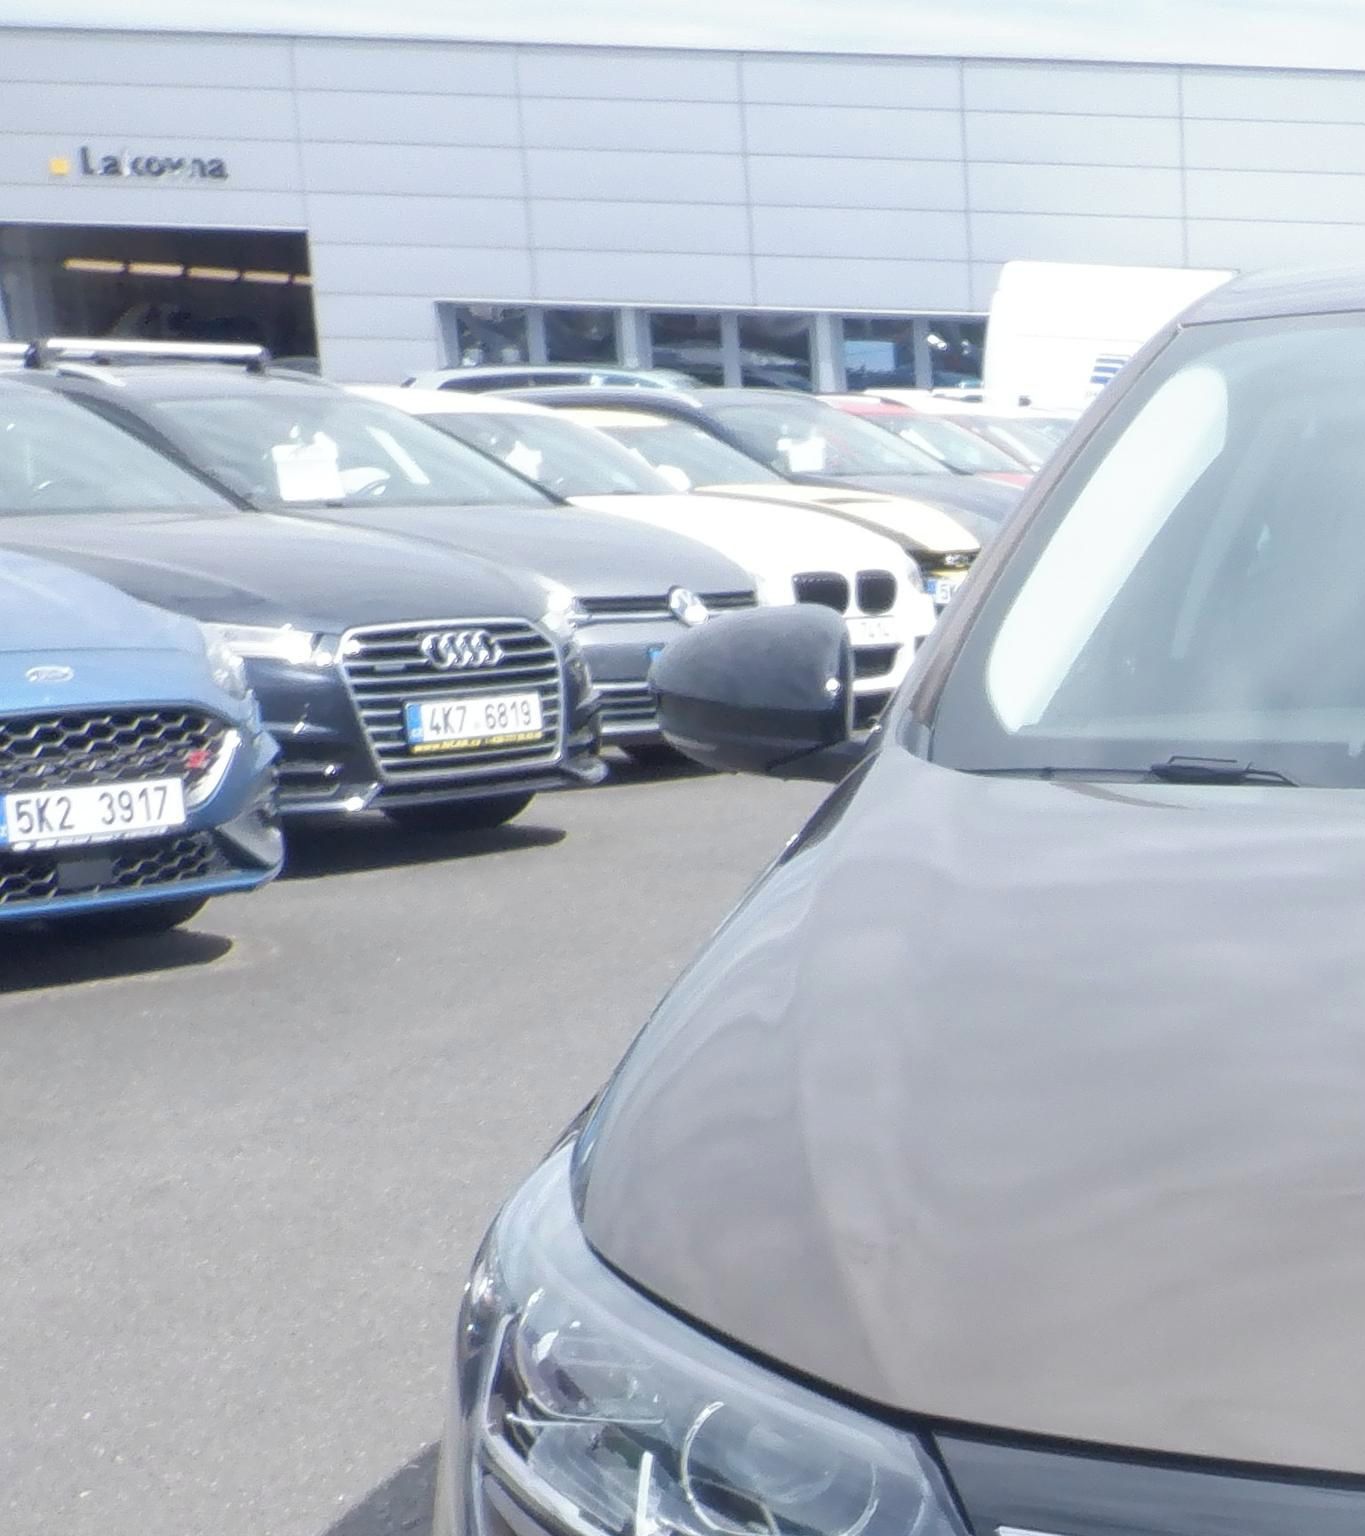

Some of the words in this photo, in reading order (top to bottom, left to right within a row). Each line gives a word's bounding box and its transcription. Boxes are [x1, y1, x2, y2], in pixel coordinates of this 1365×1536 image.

[429, 704, 466, 734] 4K7
[484, 700, 531, 730] 6819
[15, 796, 75, 834] 5K2
[98, 785, 168, 825] 3917
